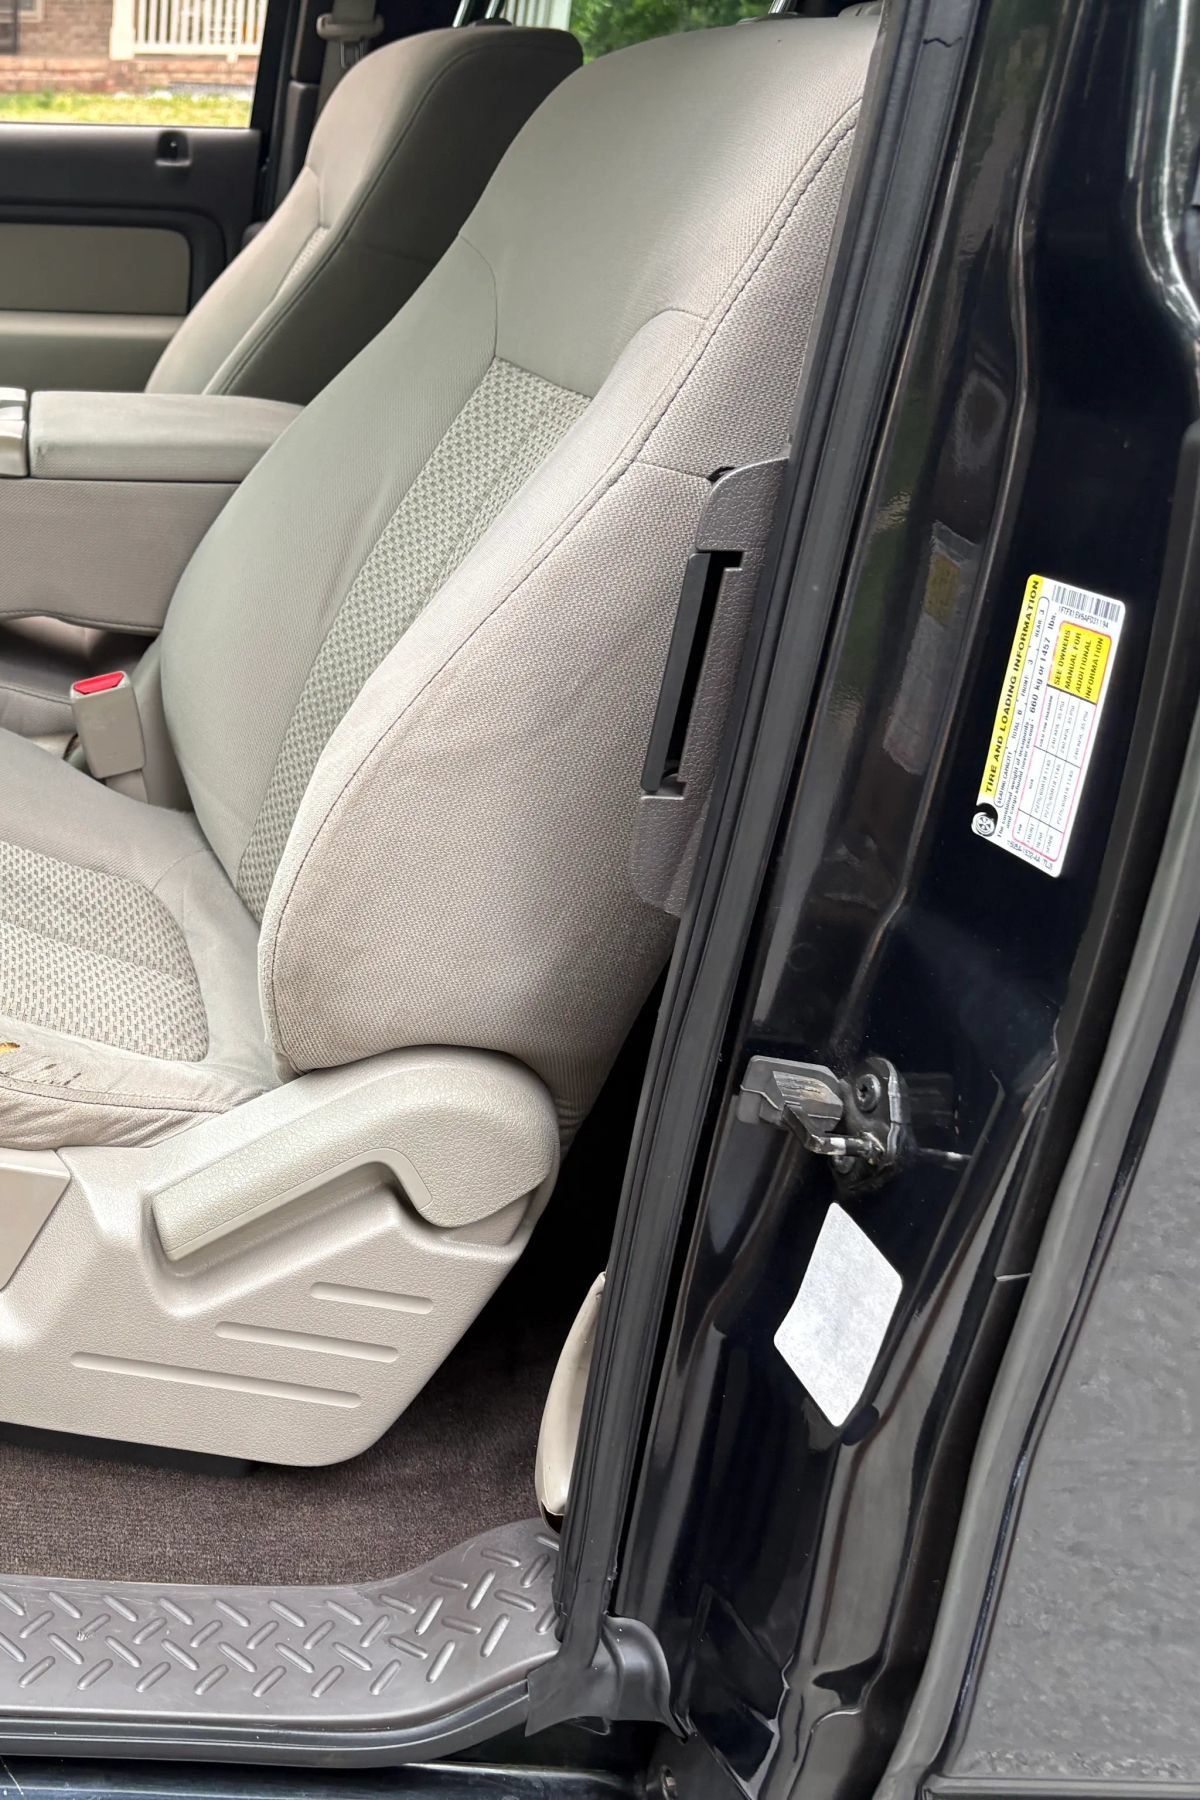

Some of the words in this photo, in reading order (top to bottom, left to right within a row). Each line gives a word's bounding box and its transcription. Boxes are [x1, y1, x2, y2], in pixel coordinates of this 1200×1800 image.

[1039, 636, 1051, 662] 1457
[1056, 628, 1072, 667] OWNERS
[1063, 652, 1078, 690] MANUAL
[1072, 631, 1082, 650] FOR
[1037, 665, 1044, 676] or
[1053, 669, 1062, 686] SEE
[1073, 638, 1092, 693] ADDITIONAL
[1083, 636, 1104, 699] INFORMATION
[984, 763, 997, 794] TIRE
[992, 734, 1004, 762] AND
[998, 674, 1018, 732] LOADING
[1012, 579, 1039, 672] INFORMATION
[1032, 677, 1043, 691] kg
[1028, 692, 1039, 714] 660
